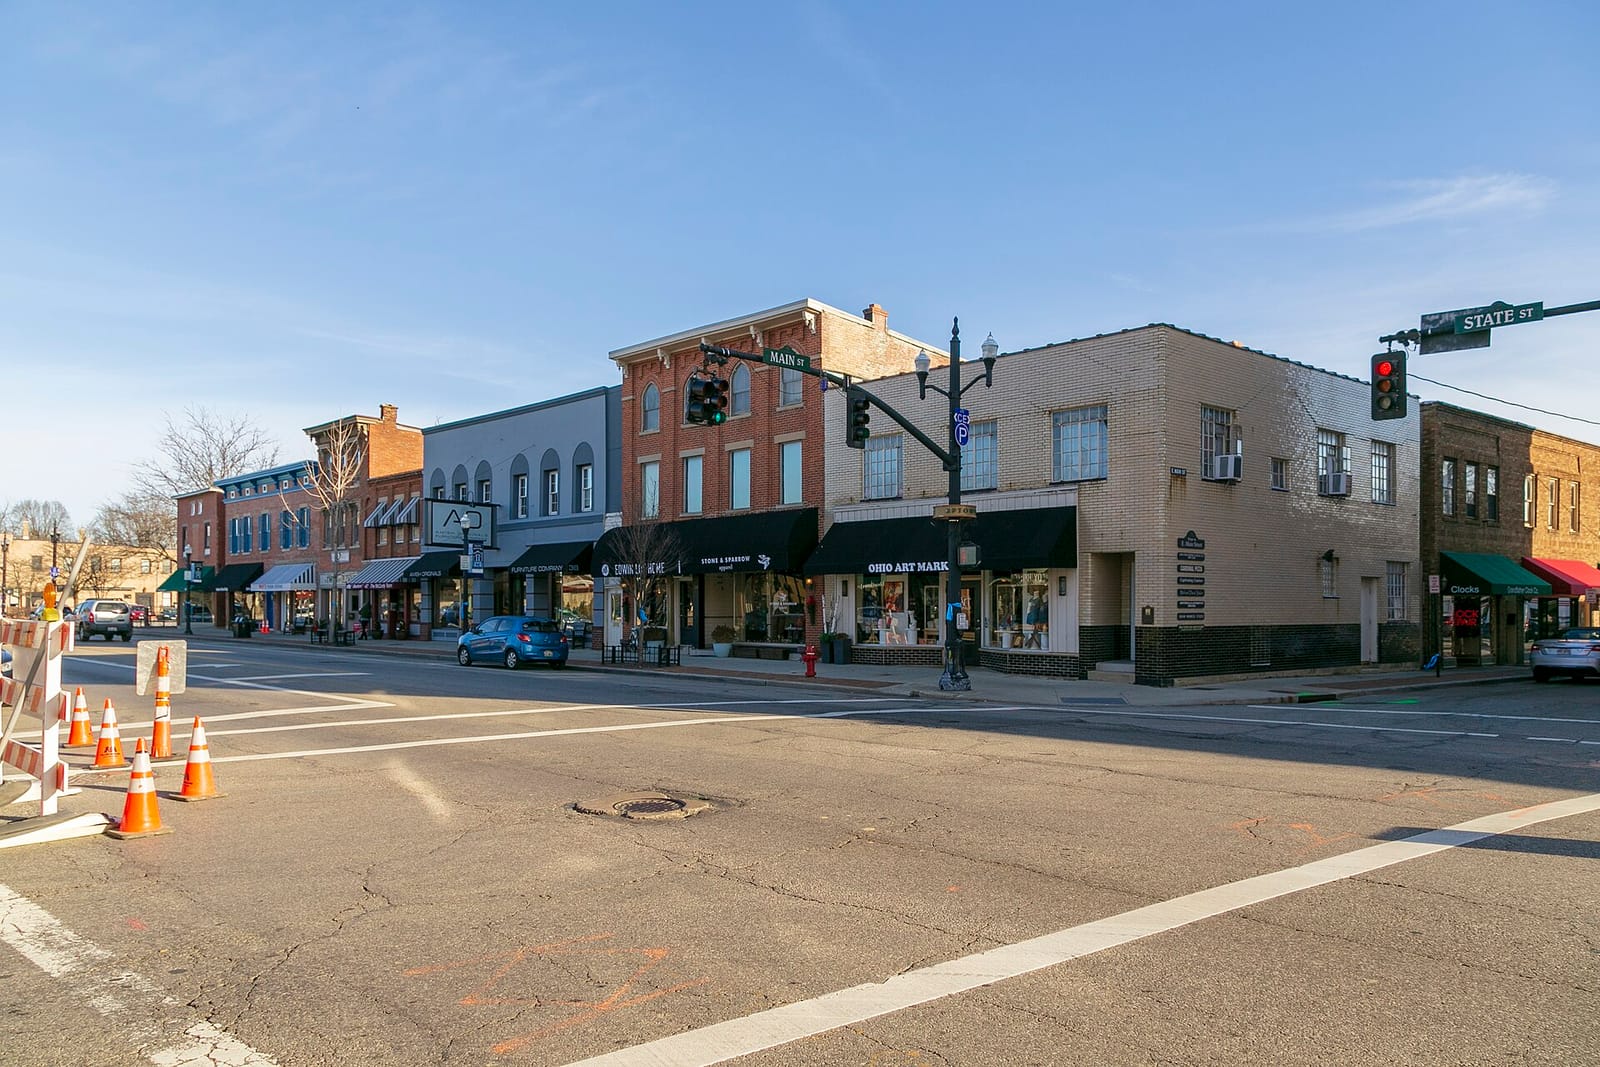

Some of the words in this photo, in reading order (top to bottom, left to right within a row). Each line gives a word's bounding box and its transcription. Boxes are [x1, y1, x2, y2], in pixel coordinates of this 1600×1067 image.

[1463, 309, 1514, 329] STATE
[1519, 308, 1534, 319] ST
[770, 351, 795, 366] MAIN
[797, 359, 805, 367] ST
[959, 427, 968, 443] P
[725, 555, 750, 563] SPARROW
[511, 565, 537, 573] FURNITURE
[538, 564, 563, 572] COMPANY
[868, 562, 893, 573] OHIO
[894, 561, 916, 572] ART
[1450, 585, 1480, 594] Clocks
